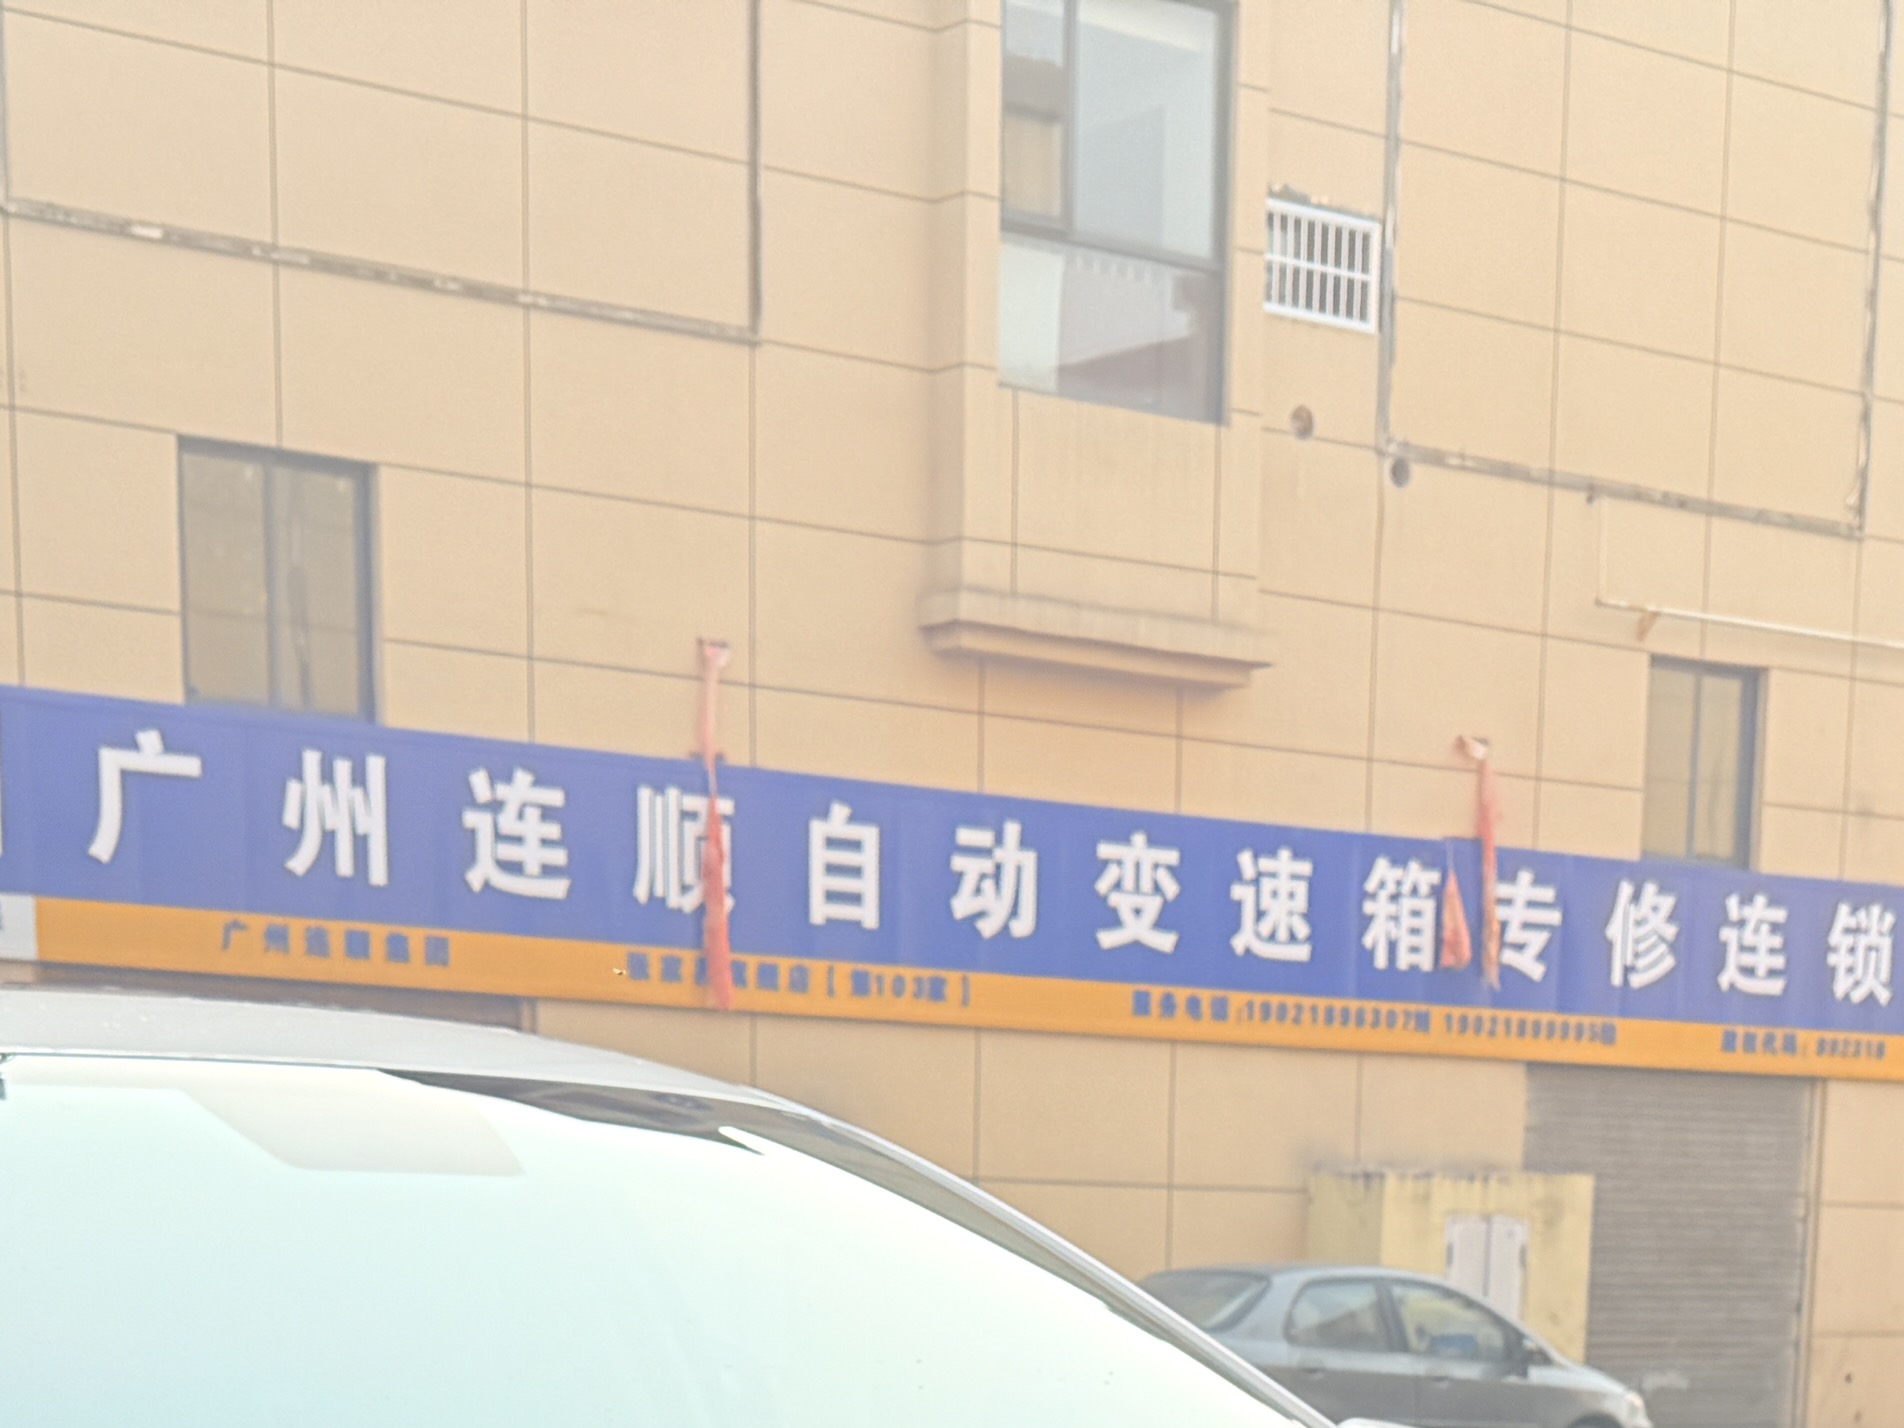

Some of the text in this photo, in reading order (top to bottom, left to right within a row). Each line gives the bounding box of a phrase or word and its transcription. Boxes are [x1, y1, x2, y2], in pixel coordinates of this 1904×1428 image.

[86, 728, 1895, 1008] 广州连顺自动变速箱专修连锁
